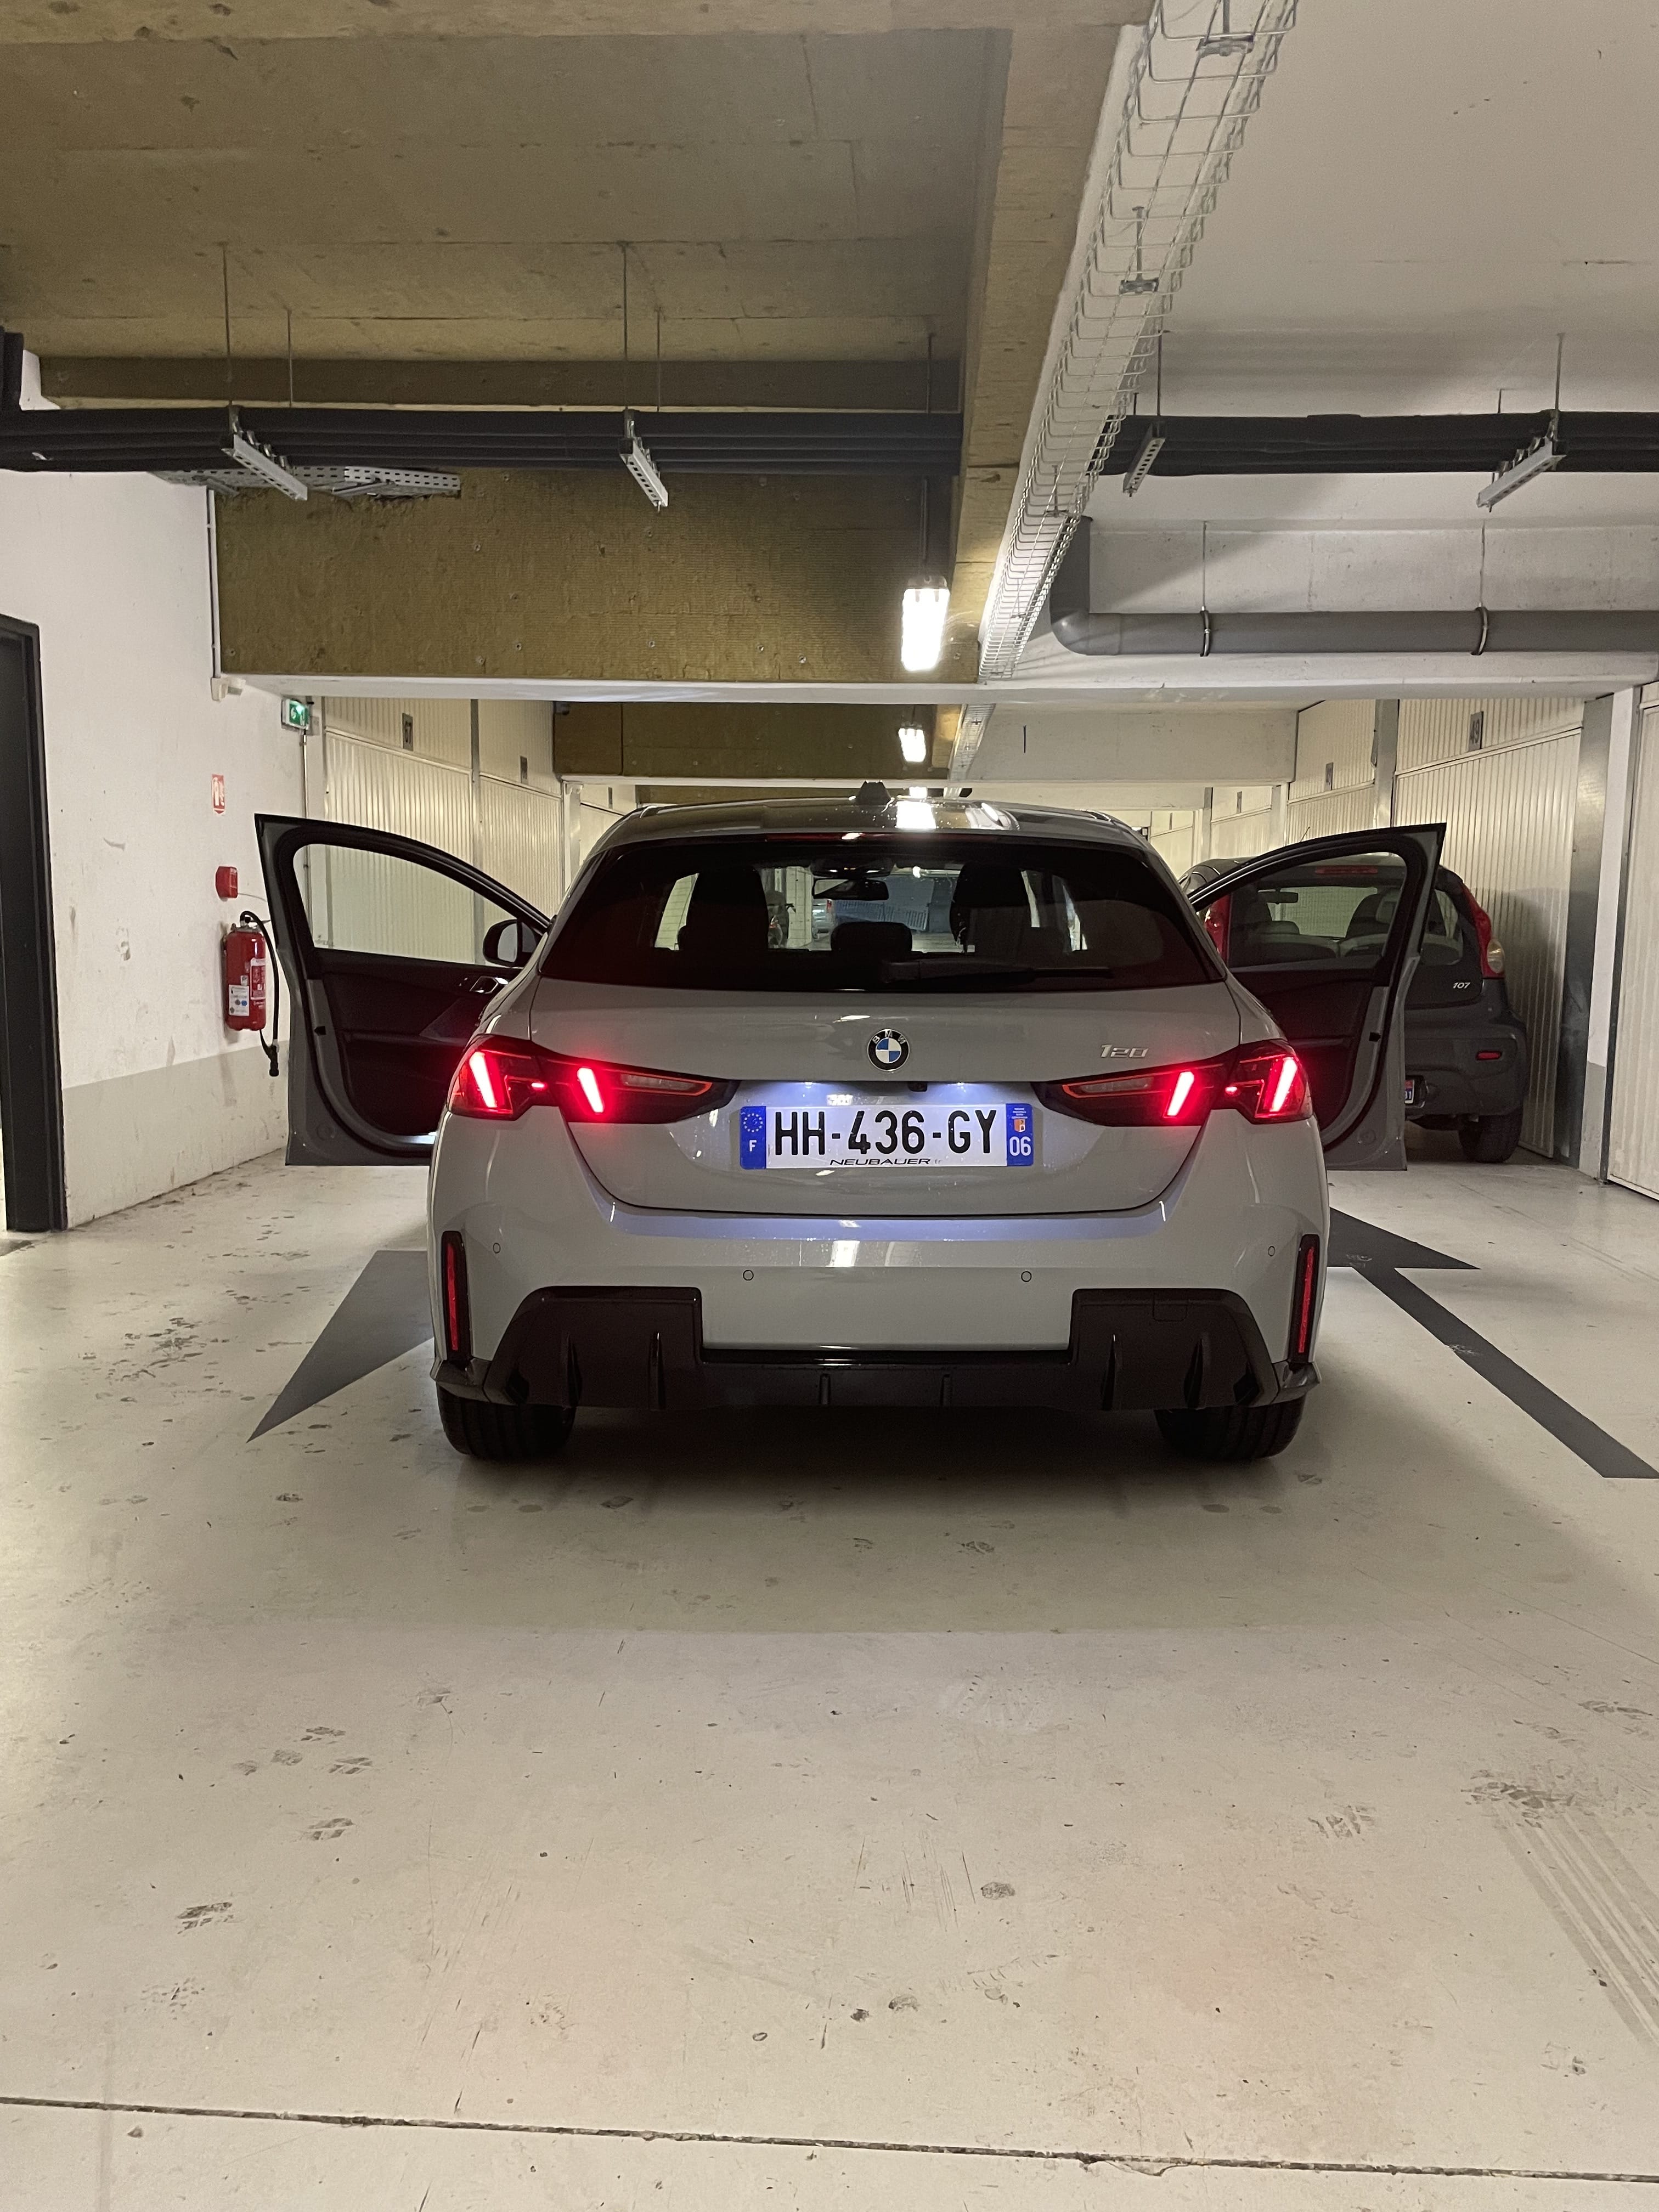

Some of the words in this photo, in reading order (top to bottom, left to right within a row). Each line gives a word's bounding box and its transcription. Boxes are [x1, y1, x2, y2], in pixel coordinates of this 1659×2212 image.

[872, 1030, 906, 1045] BMW
[1101, 1044, 1149, 1058] 120
[775, 1110, 997, 1156] HH-436-GY
[749, 1139, 757, 1152] F
[1009, 1136, 1031, 1156] 06
